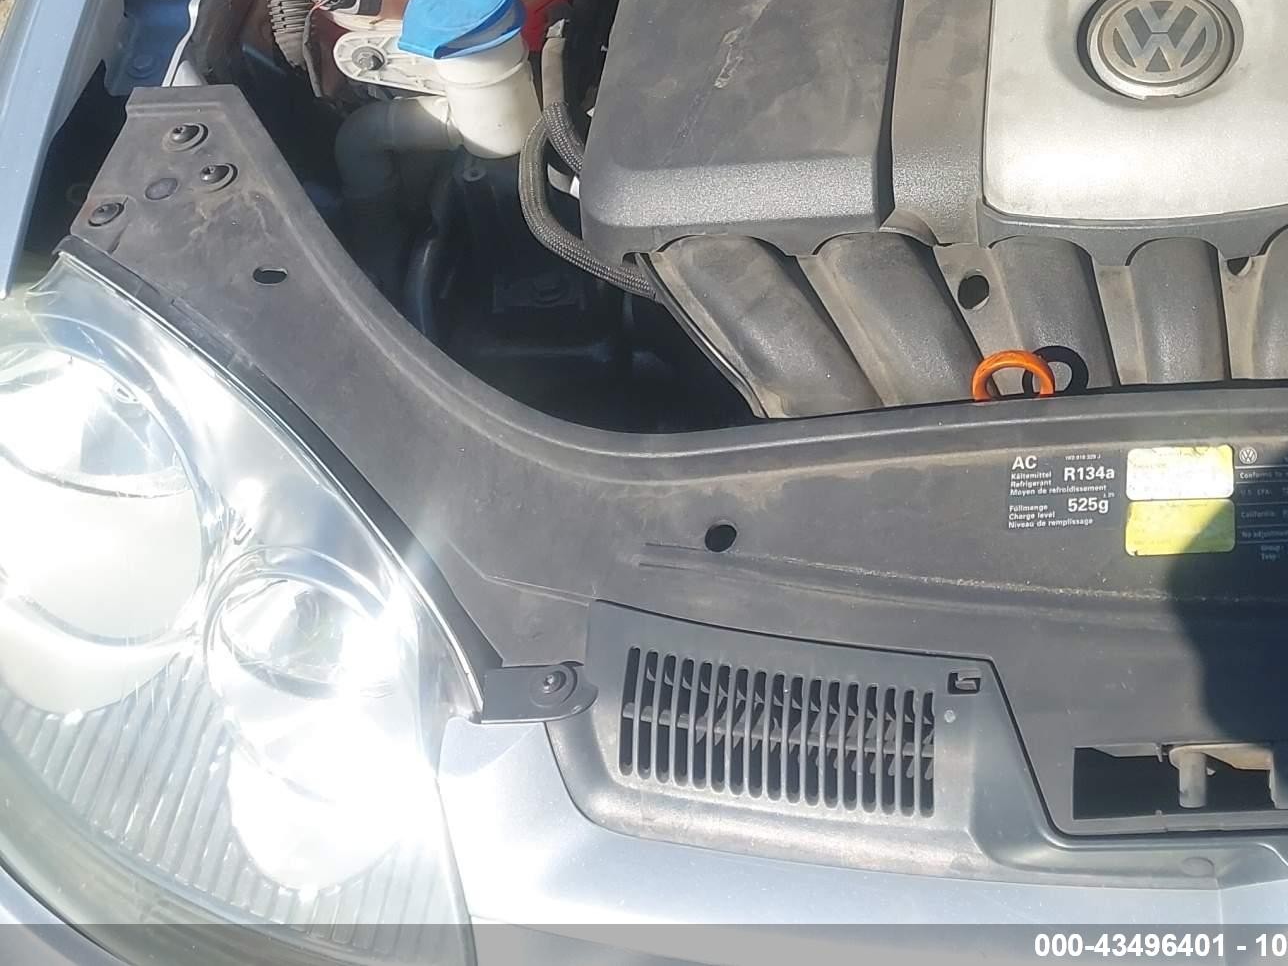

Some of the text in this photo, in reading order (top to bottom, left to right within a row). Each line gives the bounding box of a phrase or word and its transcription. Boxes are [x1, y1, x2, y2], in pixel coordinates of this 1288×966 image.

[1012, 455, 1037, 470] AC
[1064, 466, 1115, 481] R134a
[1011, 480, 1052, 488] Refrigerant
[1049, 485, 1107, 494] refroidissement
[1068, 497, 1109, 514] 525g
[1009, 513, 1035, 521] Charge
[1009, 521, 1034, 529] Niveau
[1049, 518, 1093, 527] remplissage
